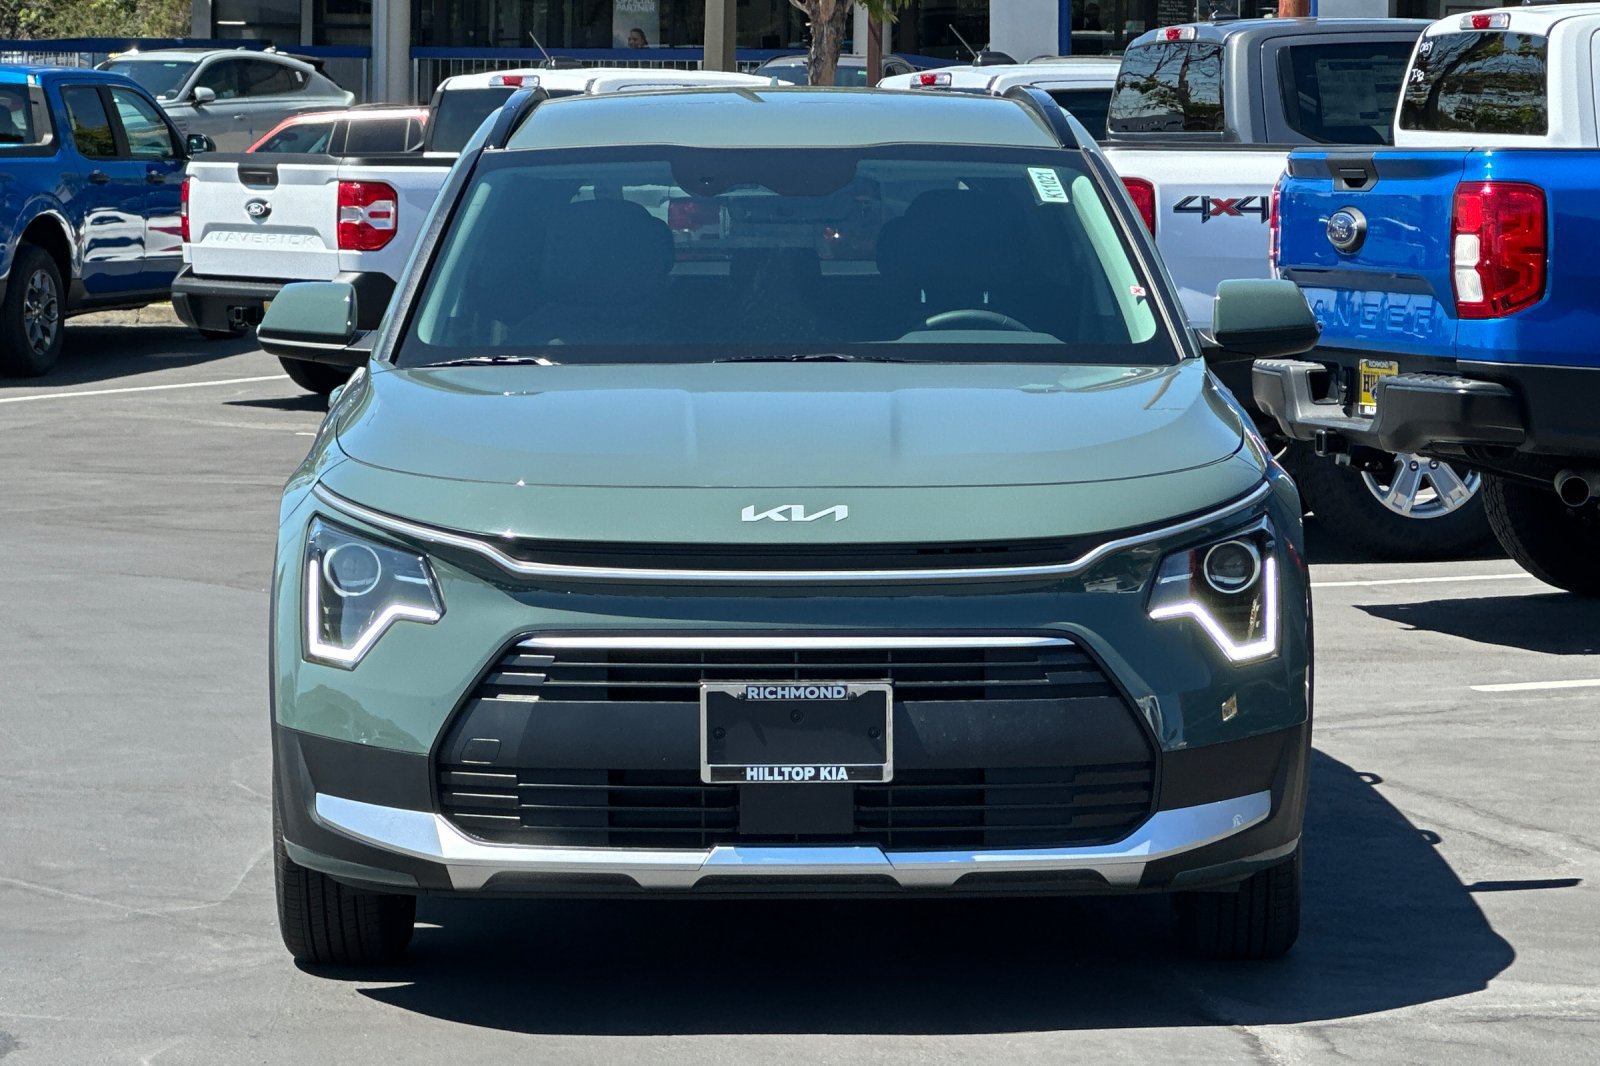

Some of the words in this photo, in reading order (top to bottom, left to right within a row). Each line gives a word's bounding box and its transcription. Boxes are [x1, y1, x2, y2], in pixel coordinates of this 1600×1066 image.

[1035, 172, 1064, 198] K11021
[207, 232, 315, 245] MAVERICK
[1313, 298, 1433, 333] ANGER
[741, 504, 848, 522] KIA
[747, 687, 846, 699] RICHMOND
[746, 767, 815, 780] HILLTOP
[820, 767, 848, 780] KIA
